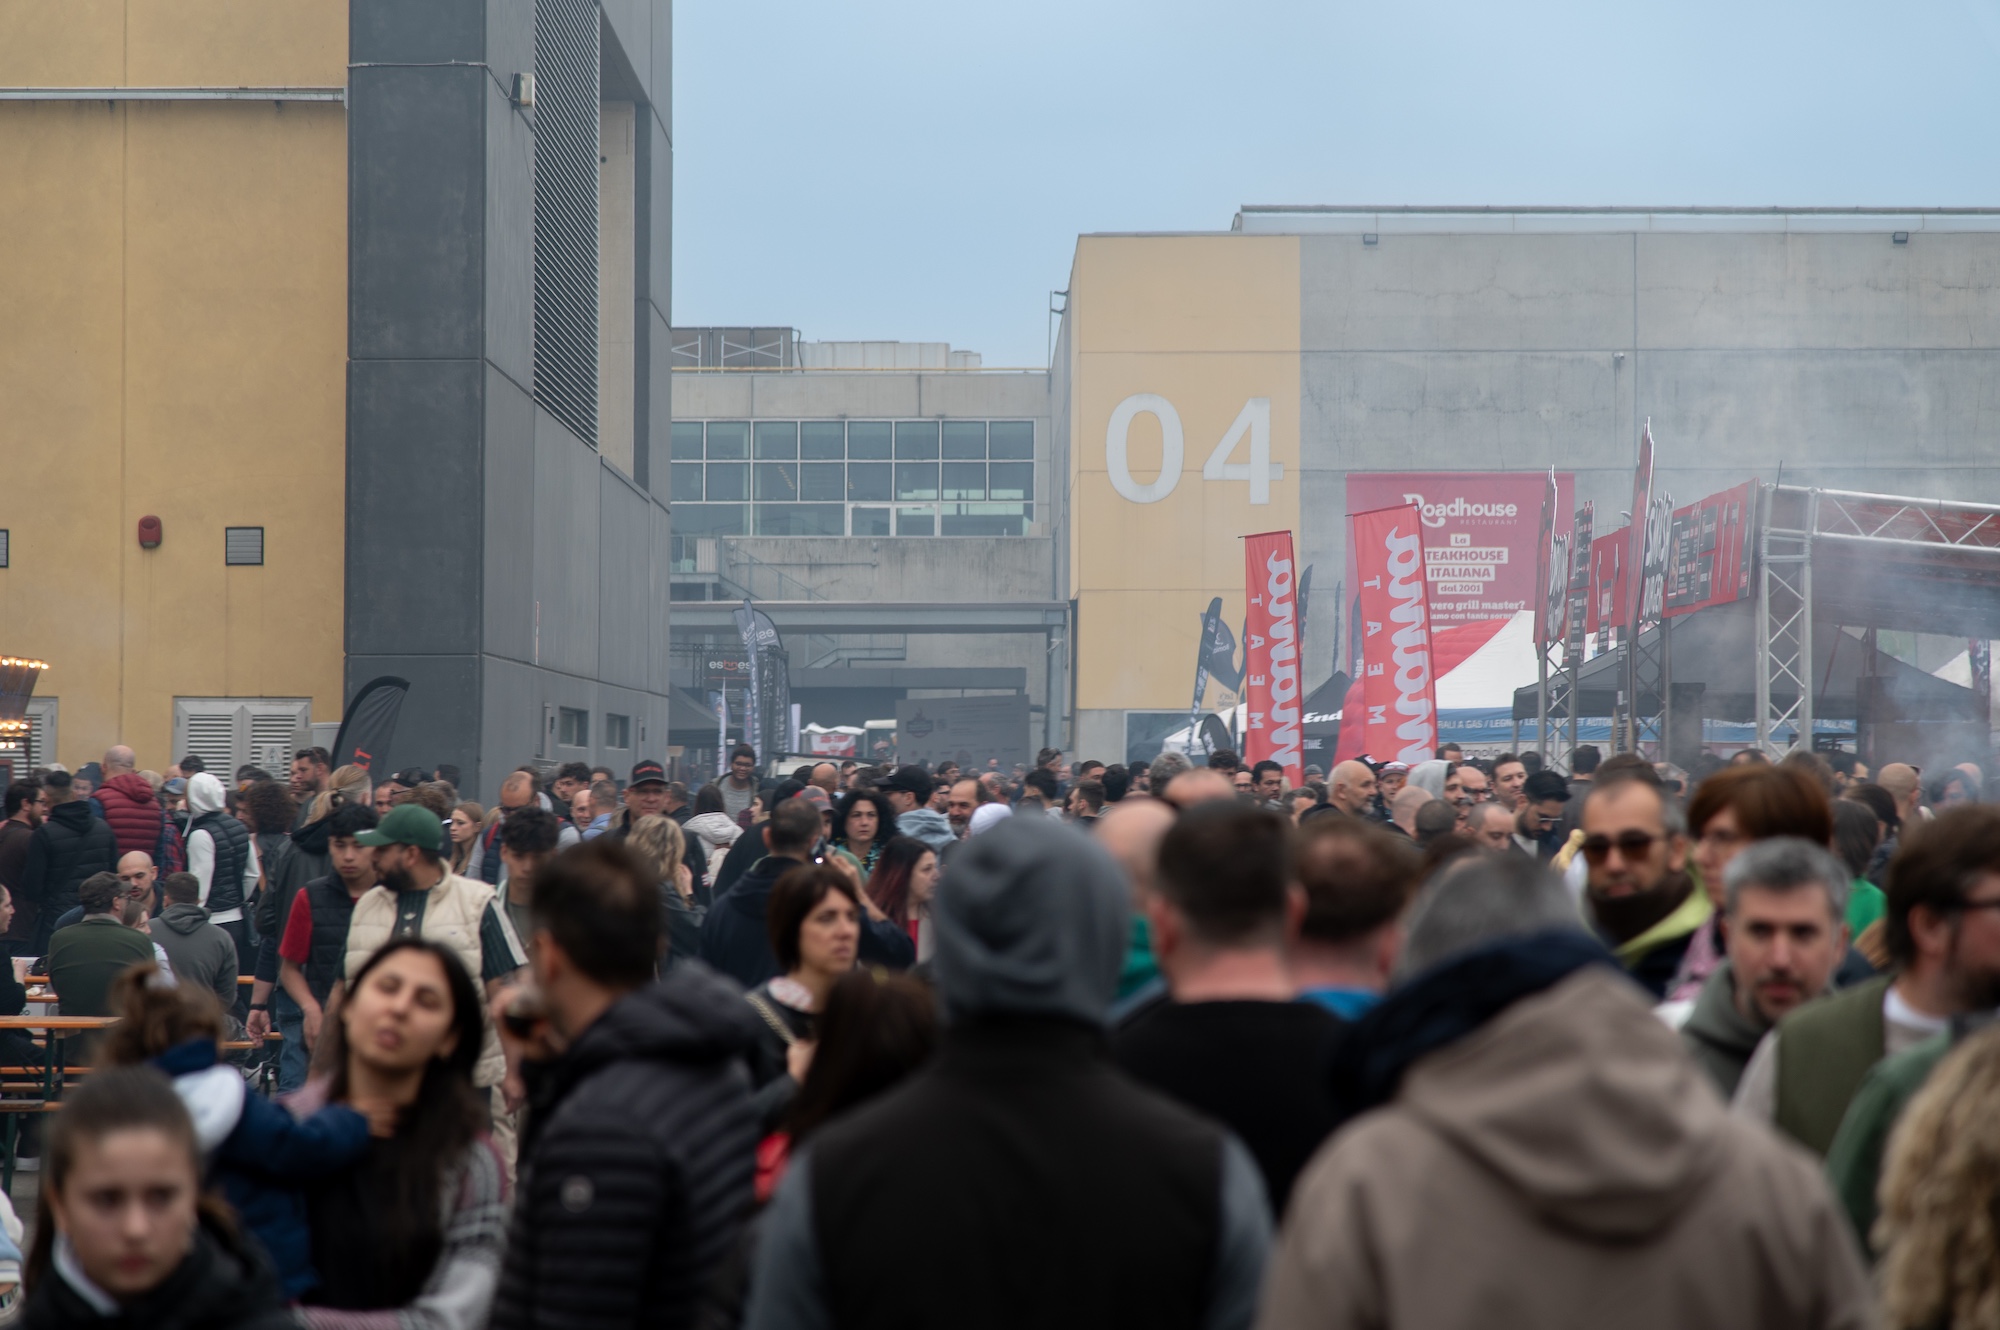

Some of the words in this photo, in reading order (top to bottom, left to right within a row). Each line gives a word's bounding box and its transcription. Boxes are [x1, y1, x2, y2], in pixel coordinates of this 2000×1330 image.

[1106, 392, 1284, 505] 04
[1402, 493, 1518, 528] Roadhouse
[1454, 536, 1467, 545] La
[1425, 551, 1504, 561] TEAKHOUSE
[1430, 567, 1491, 578] ITALIANA
[1440, 584, 1457, 592] dal
[1459, 584, 1481, 592] 2001
[1430, 602, 1454, 610] vero
[1456, 600, 1480, 611] grill
[1481, 600, 1526, 610] master?
[1437, 720, 1456, 729] RALI
[1465, 719, 1483, 729] GAS
[1489, 718, 1514, 728] LEGN
